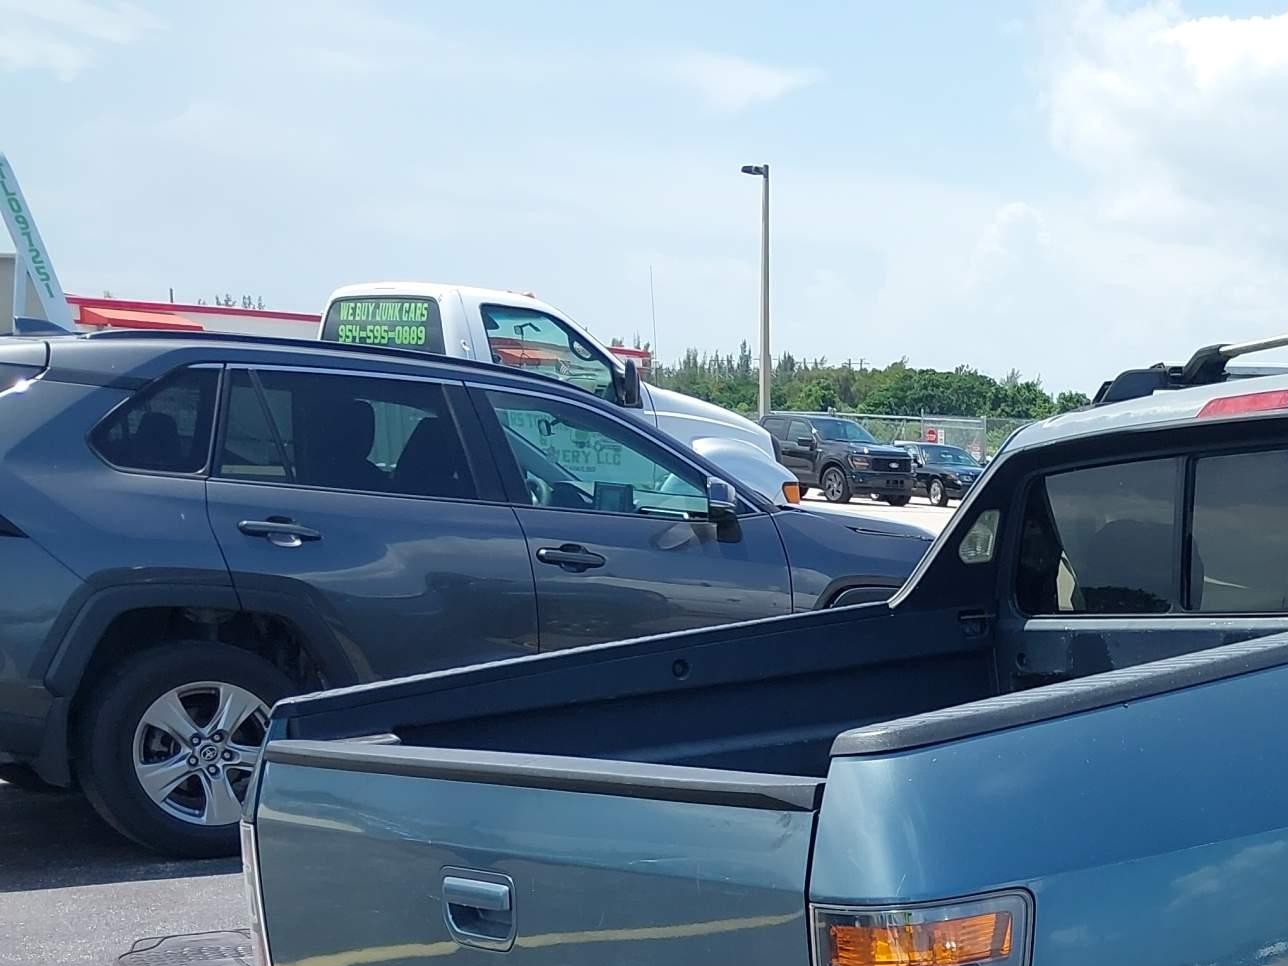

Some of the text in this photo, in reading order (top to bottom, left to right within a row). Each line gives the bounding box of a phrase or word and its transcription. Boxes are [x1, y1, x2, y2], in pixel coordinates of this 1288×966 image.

[340, 302, 429, 321] WE BUY JUNK CARS
[338, 325, 426, 344] 954-595-0889
